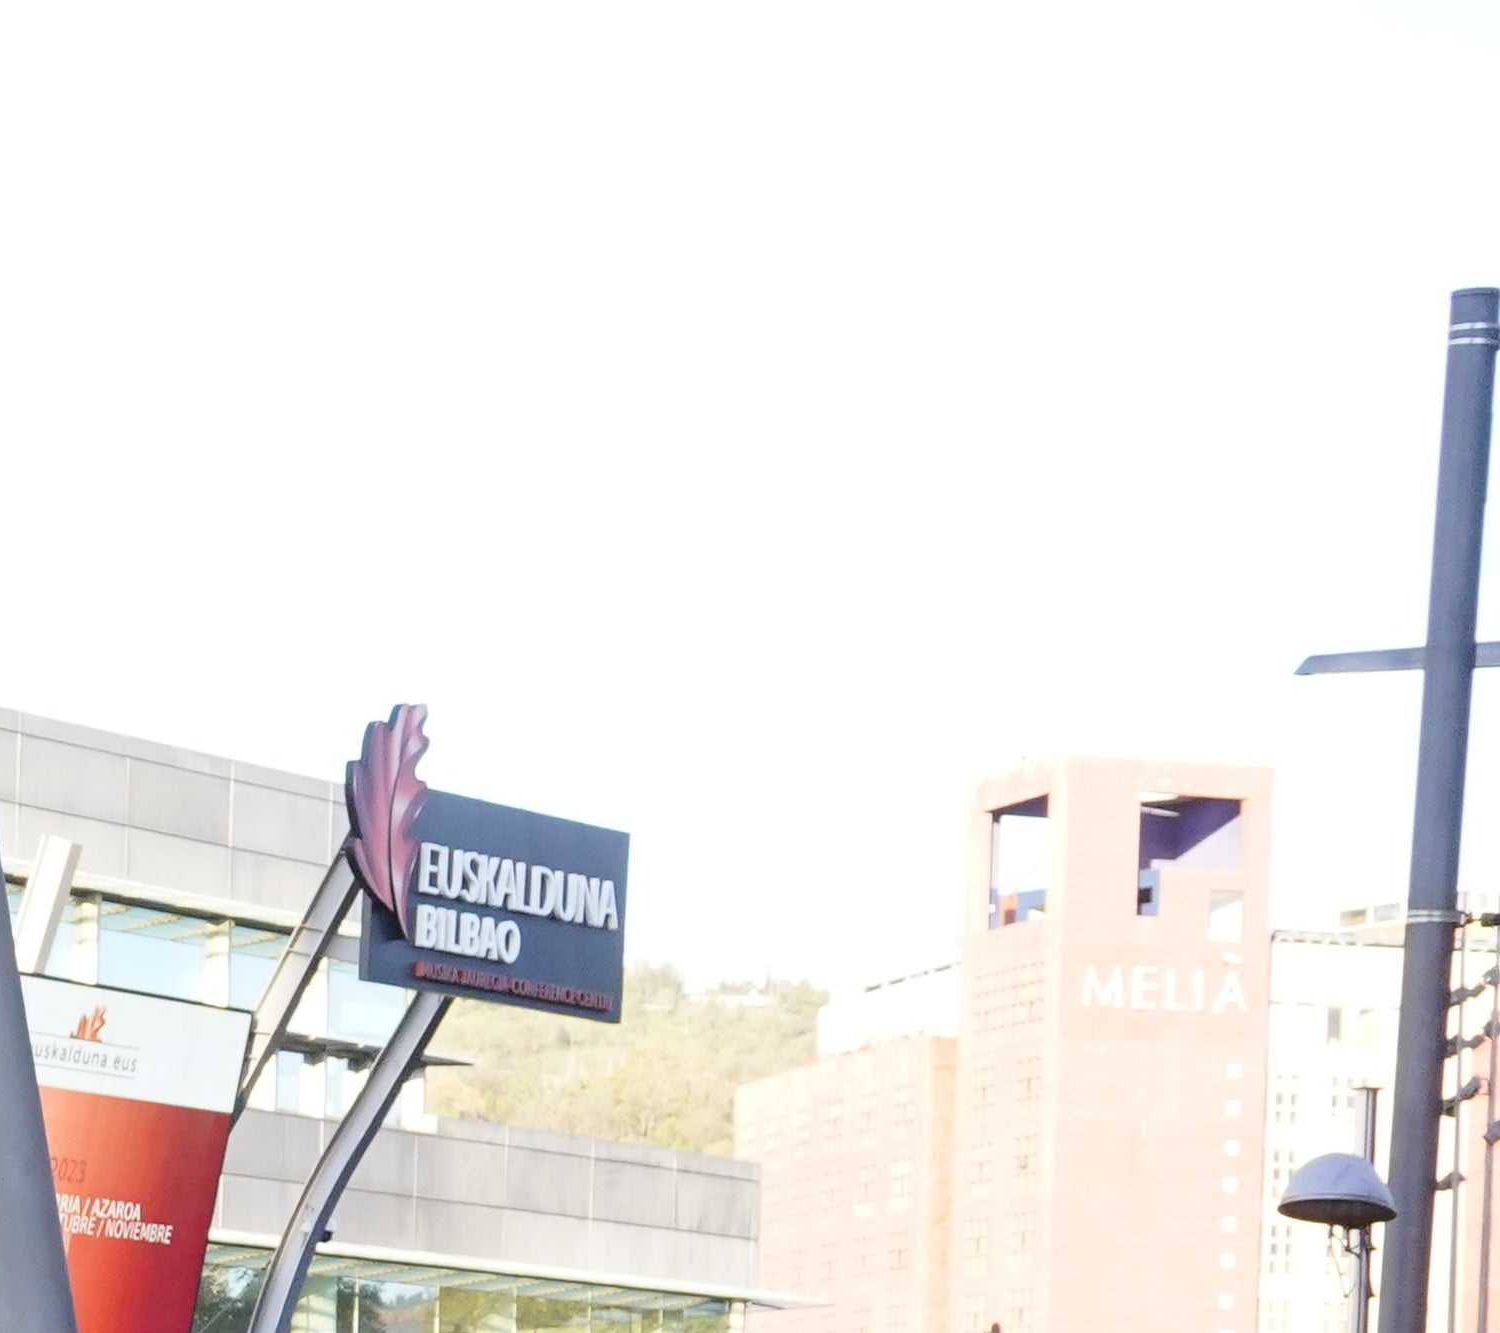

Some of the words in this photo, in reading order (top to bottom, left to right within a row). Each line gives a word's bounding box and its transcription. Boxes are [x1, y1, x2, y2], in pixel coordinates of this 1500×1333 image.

[418, 842, 619, 931] EUSKALDUNA
[414, 904, 521, 964] BILBAO
[31, 1043, 138, 1073] uskalduna.eus
[91, 1198, 141, 1221] AZAROA
[105, 1219, 174, 1245] NOVIEMBRE
